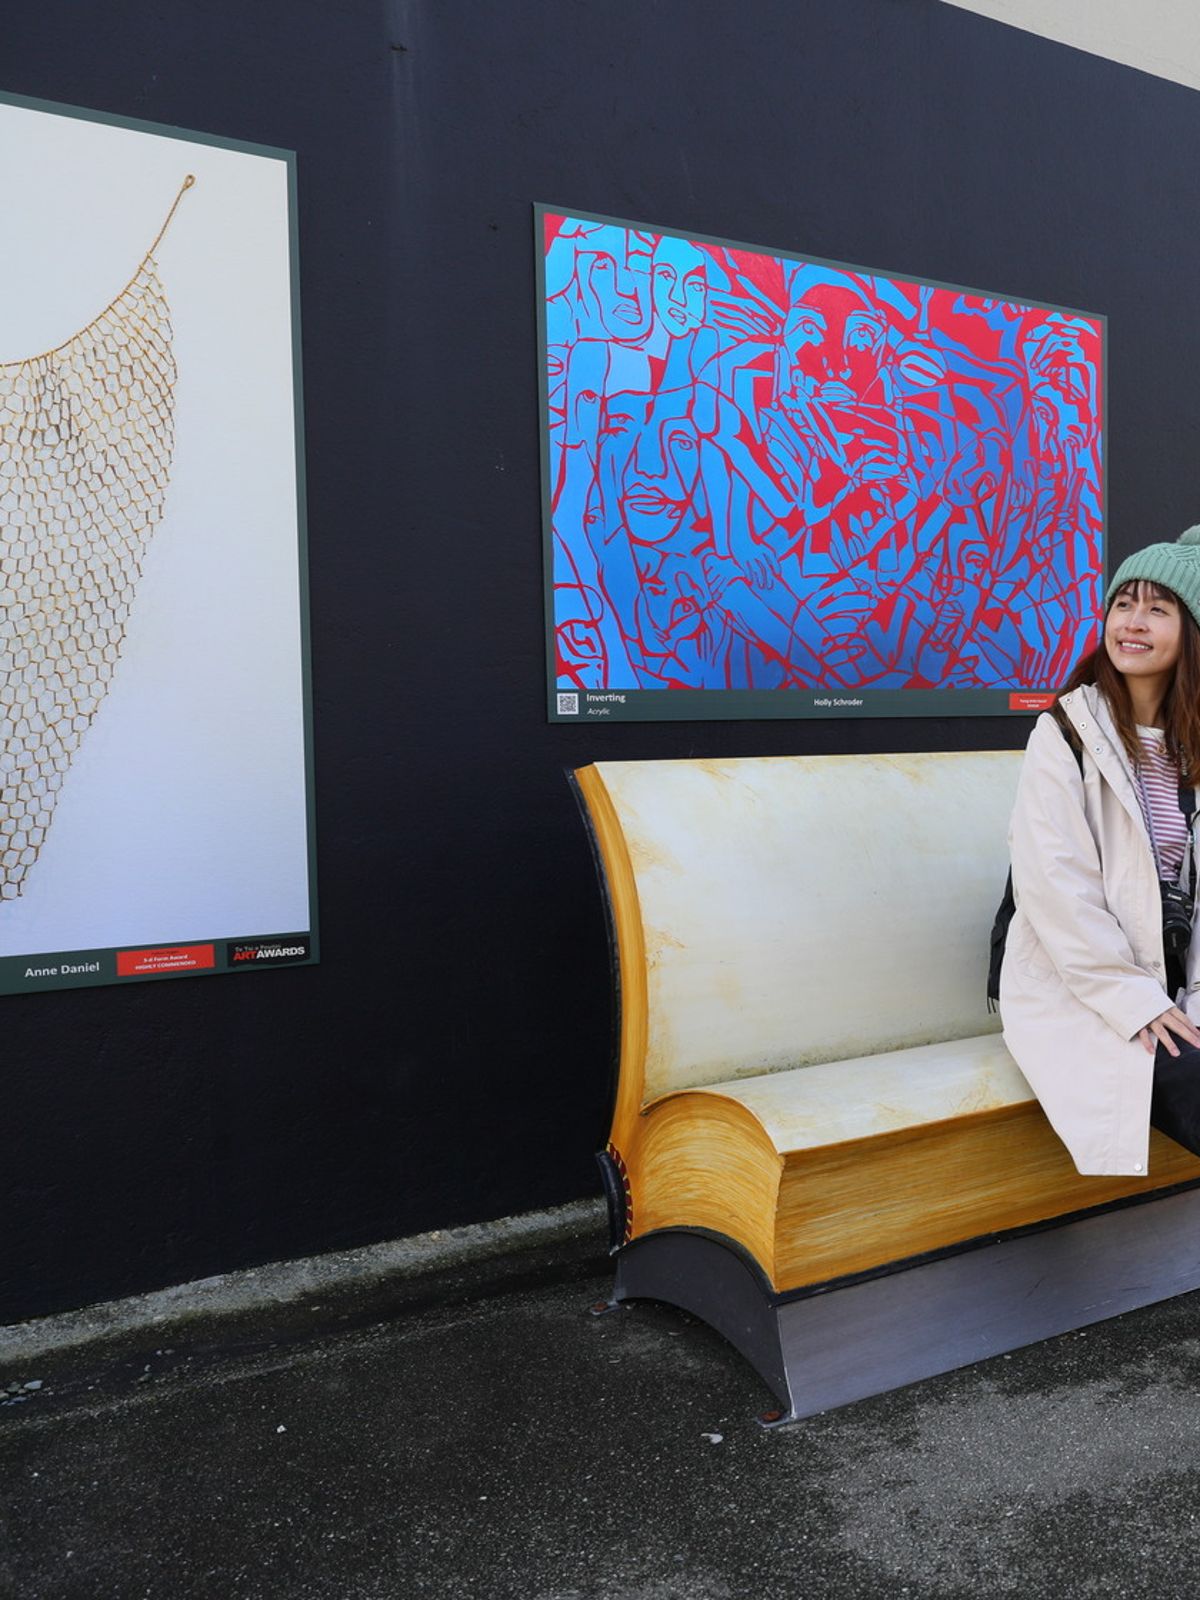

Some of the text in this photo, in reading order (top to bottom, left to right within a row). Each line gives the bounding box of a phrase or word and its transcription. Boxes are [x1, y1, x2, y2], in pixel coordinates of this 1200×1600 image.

[586, 693, 626, 703] Inverting
[813, 698, 832, 707] Holly
[587, 707, 611, 716] Acrylic
[24, 961, 100, 978] Anne Daniel
